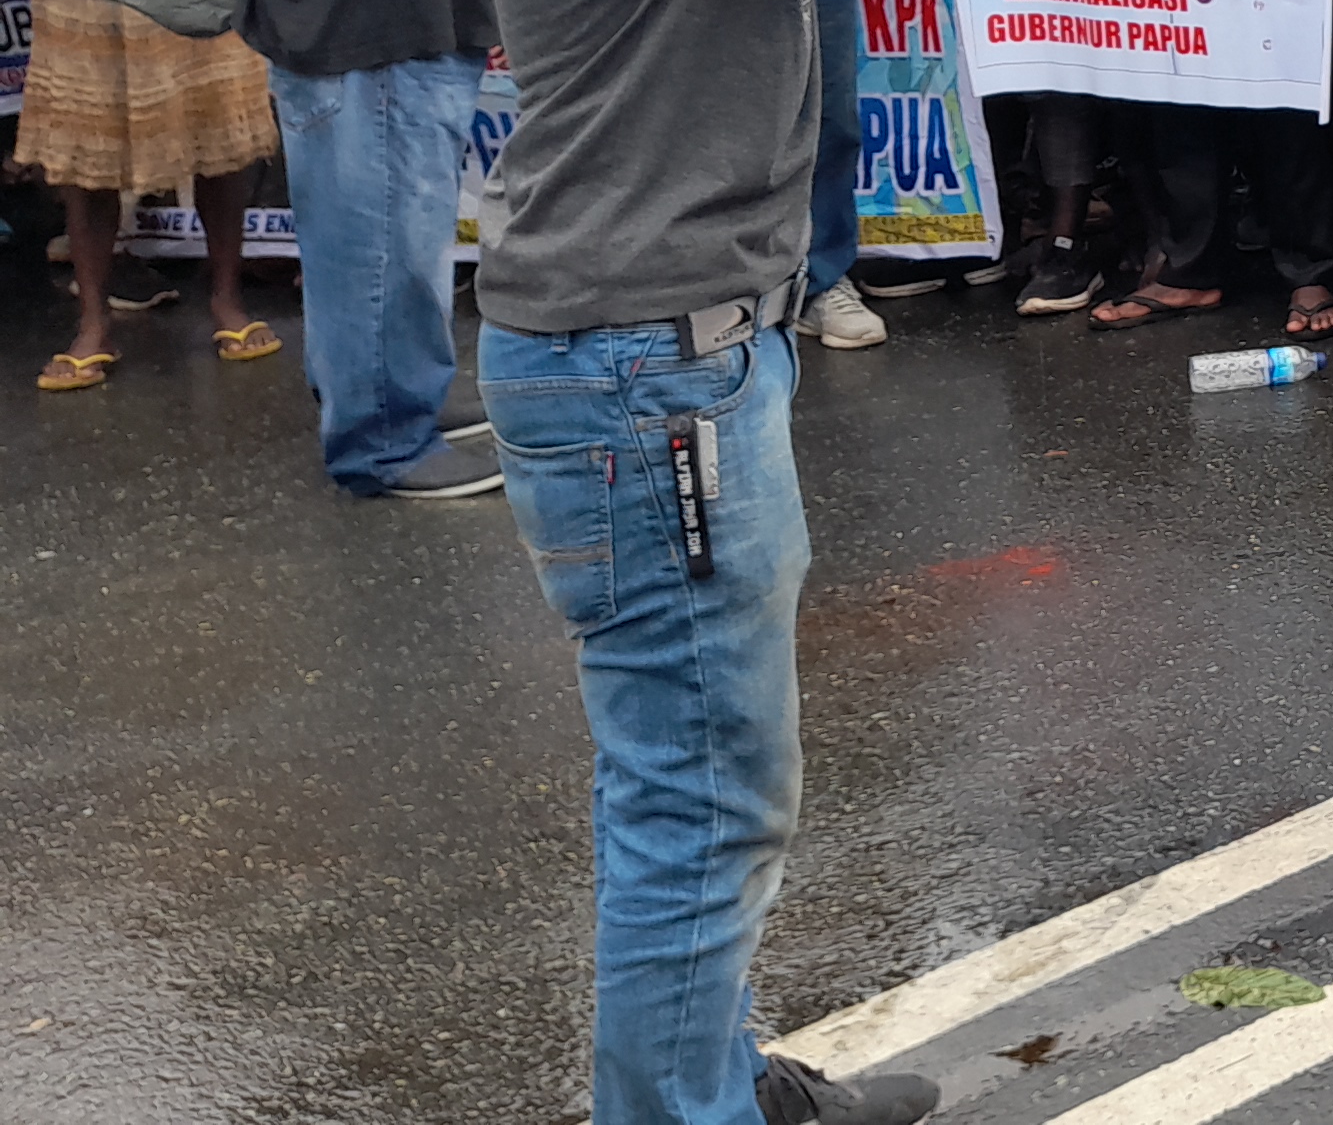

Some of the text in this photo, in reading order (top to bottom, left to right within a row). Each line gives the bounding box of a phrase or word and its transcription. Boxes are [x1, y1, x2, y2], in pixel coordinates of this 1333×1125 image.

[987, 14, 1208, 56] GUBERNUR PAPUA
[854, 98, 958, 192] PUA
